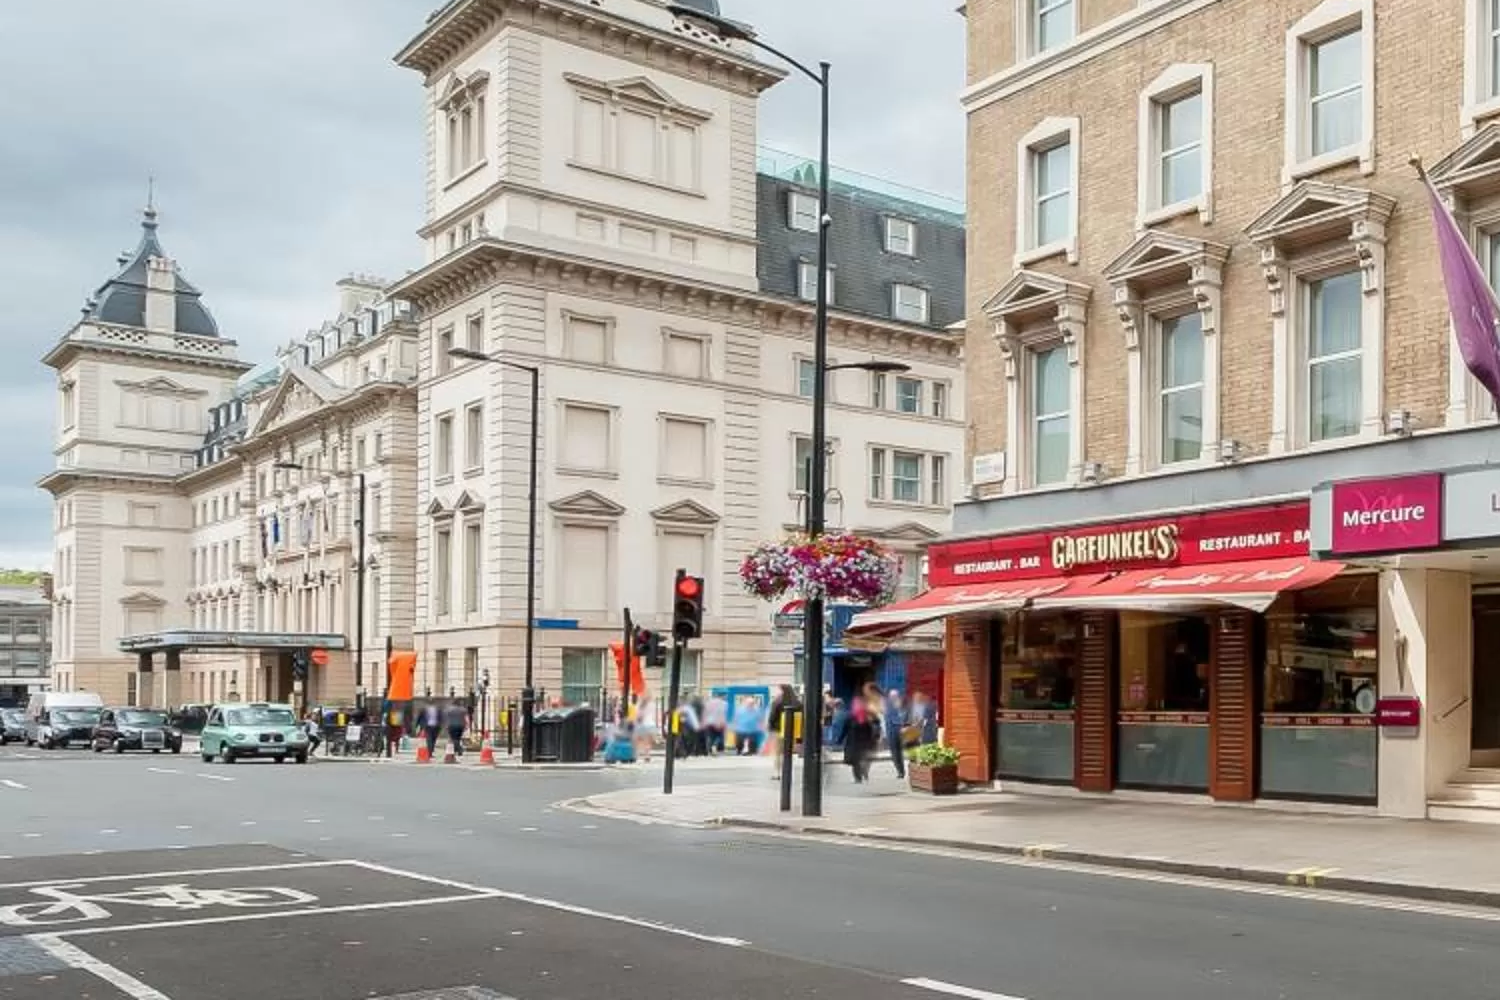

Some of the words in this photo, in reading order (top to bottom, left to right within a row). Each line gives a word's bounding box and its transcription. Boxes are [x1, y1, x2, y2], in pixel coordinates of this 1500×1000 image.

[1343, 504, 1425, 528] Mercure
[1051, 523, 1178, 570] GARFUNKEL'S
[1199, 532, 1282, 552] RESTAURANT
[953, 559, 1013, 575] RESTAURANT
[1020, 556, 1041, 569] BAR
